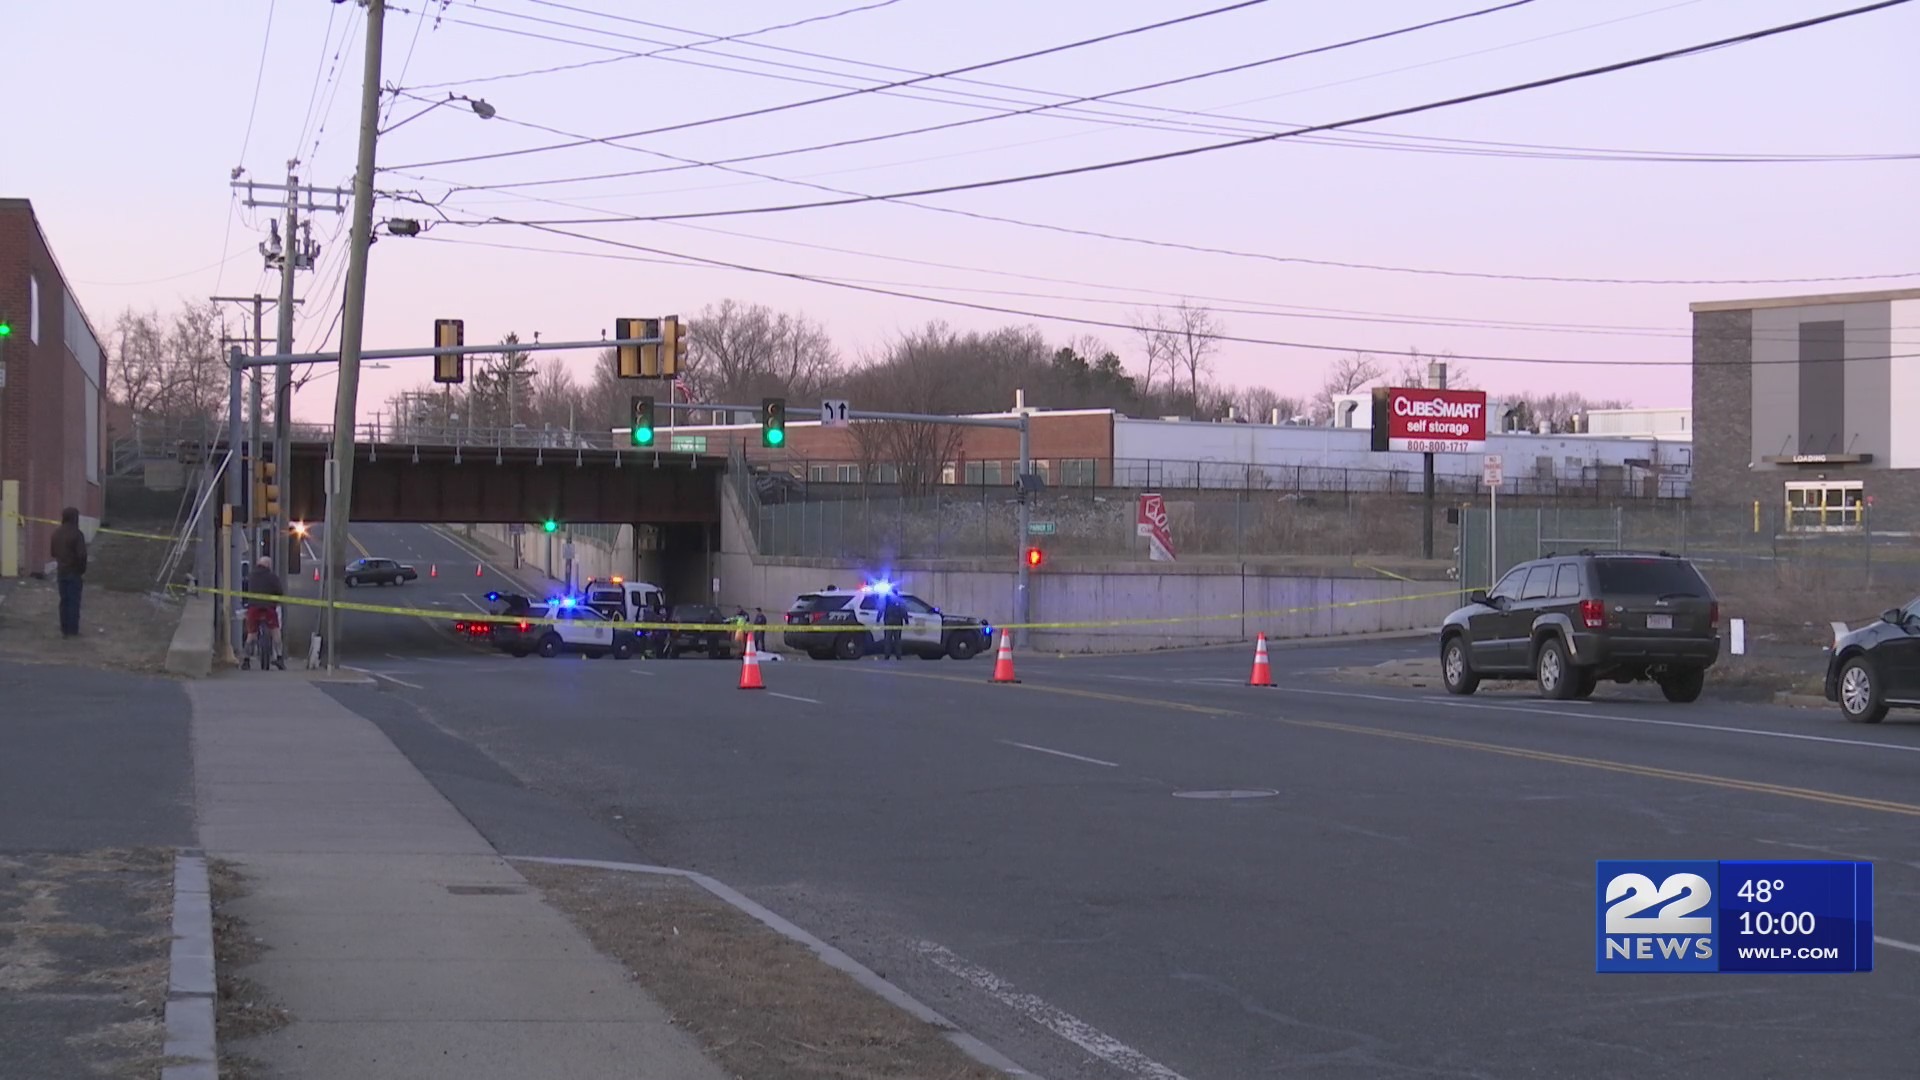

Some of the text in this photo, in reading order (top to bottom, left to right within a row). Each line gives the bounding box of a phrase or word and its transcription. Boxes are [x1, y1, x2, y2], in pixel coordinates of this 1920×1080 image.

[1407, 419, 1469, 436] self storage
[1407, 440, 1469, 452] 800-800-1717
[1792, 454, 1827, 463] LOADING
